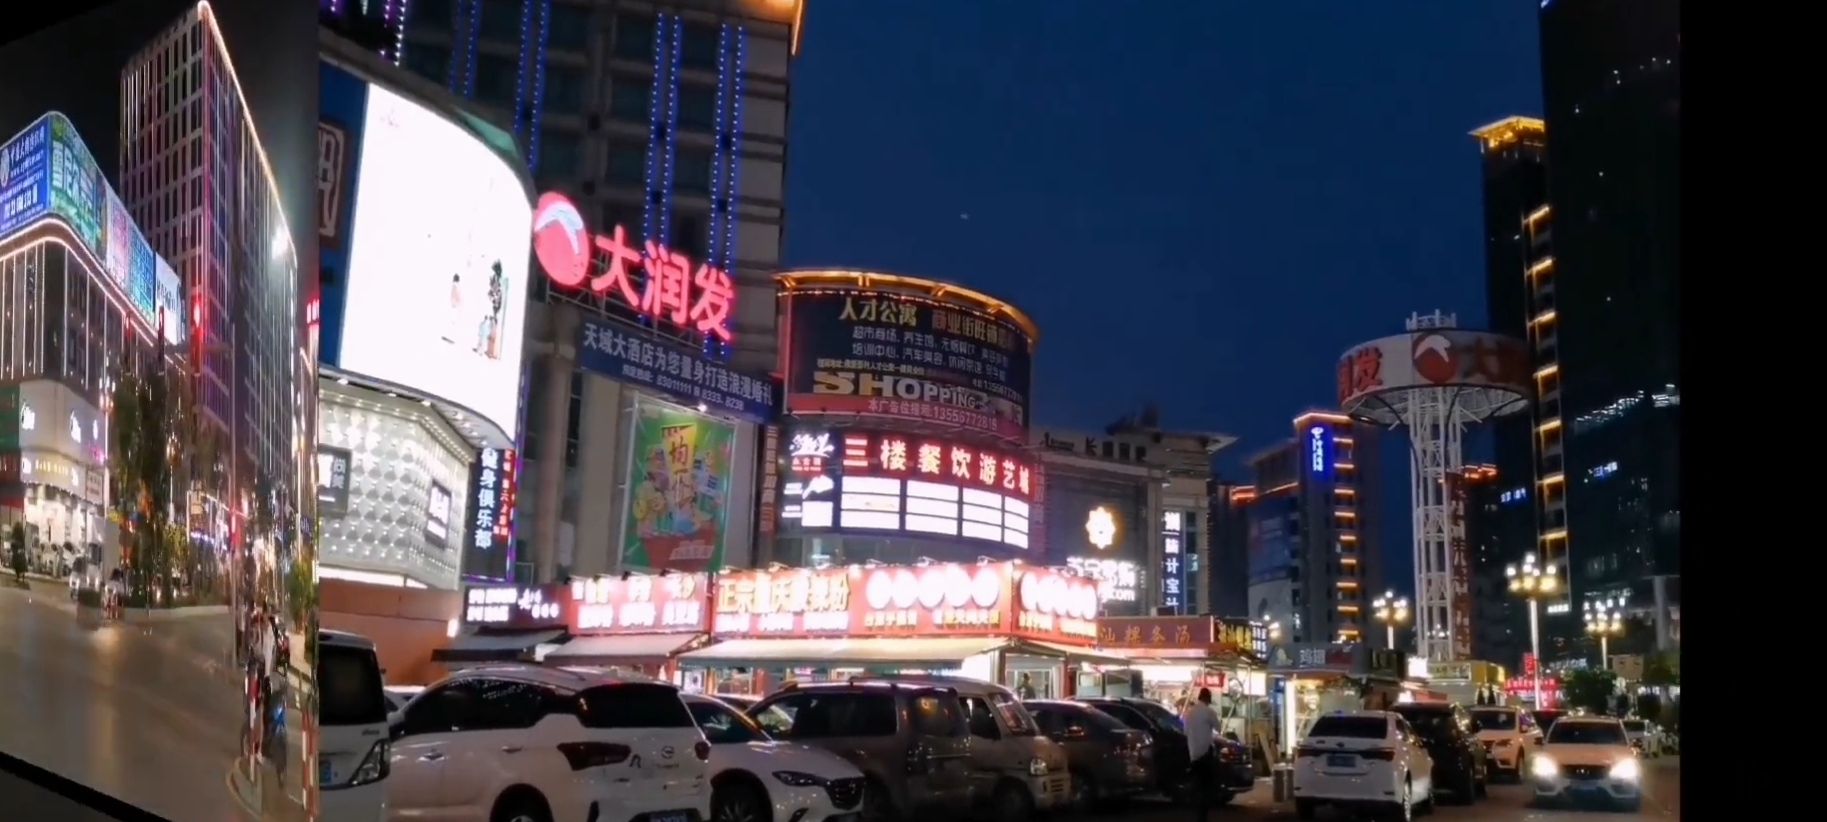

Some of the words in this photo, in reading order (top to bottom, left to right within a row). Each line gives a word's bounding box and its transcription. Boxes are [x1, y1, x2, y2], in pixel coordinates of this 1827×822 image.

[590, 223, 735, 341] 大润发
[838, 296, 917, 328] 人才公寓
[813, 371, 976, 408] SHOPPING
[843, 438, 1030, 495] 三楼餐饮游艺城
[474, 446, 498, 549] 健身俱乐部
